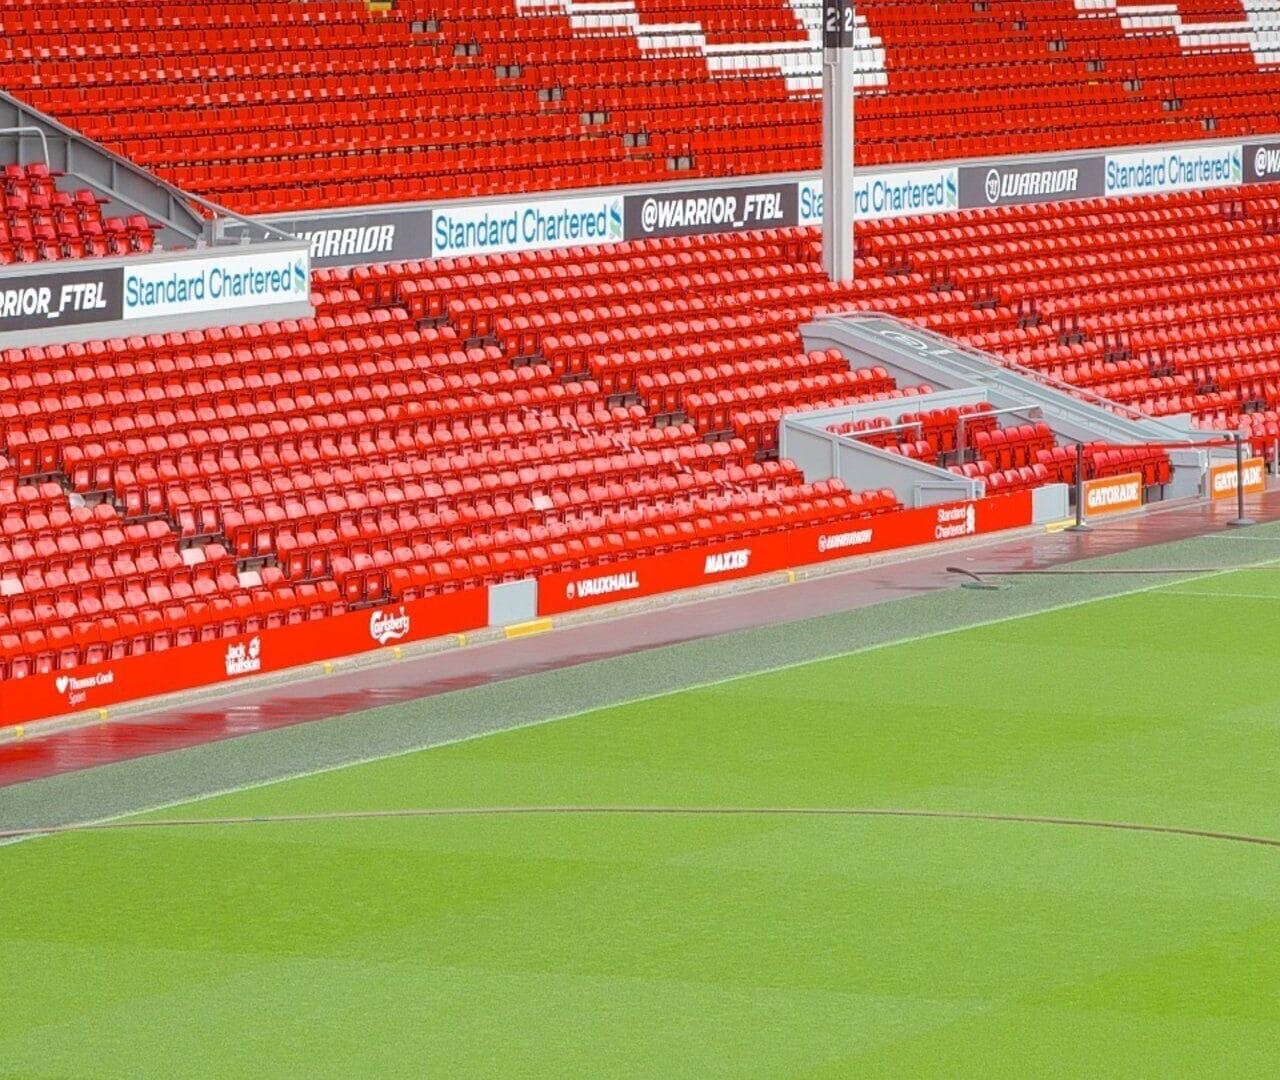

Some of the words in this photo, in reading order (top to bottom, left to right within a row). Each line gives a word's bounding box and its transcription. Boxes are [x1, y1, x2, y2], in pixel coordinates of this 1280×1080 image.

[1001, 169, 1078, 196] WARRIOR
[1108, 157, 1165, 190] Standard
[1168, 152, 1230, 184] Chartered
[641, 193, 784, 229] @WARRIOR_FTBL
[801, 182, 869, 219] Stard
[873, 176, 943, 212] Chartered
[289, 225, 395, 257] ARRIOR
[435, 211, 517, 251] Standard
[523, 206, 607, 243] Chartered
[126, 267, 205, 307] Standard
[209, 262, 291, 299] Chartered
[1214, 466, 1262, 491] GATOADE
[1088, 482, 1139, 508] GATORADE
[938, 506, 966, 522] Standard
[704, 549, 750, 573] MAXXIS
[577, 571, 640, 597] VAUXHALL
[370, 607, 410, 644] Carlsberg
[228, 643, 246, 658] Jack
[70, 675, 96, 690] Thomas
[97, 671, 114, 685] Cook
